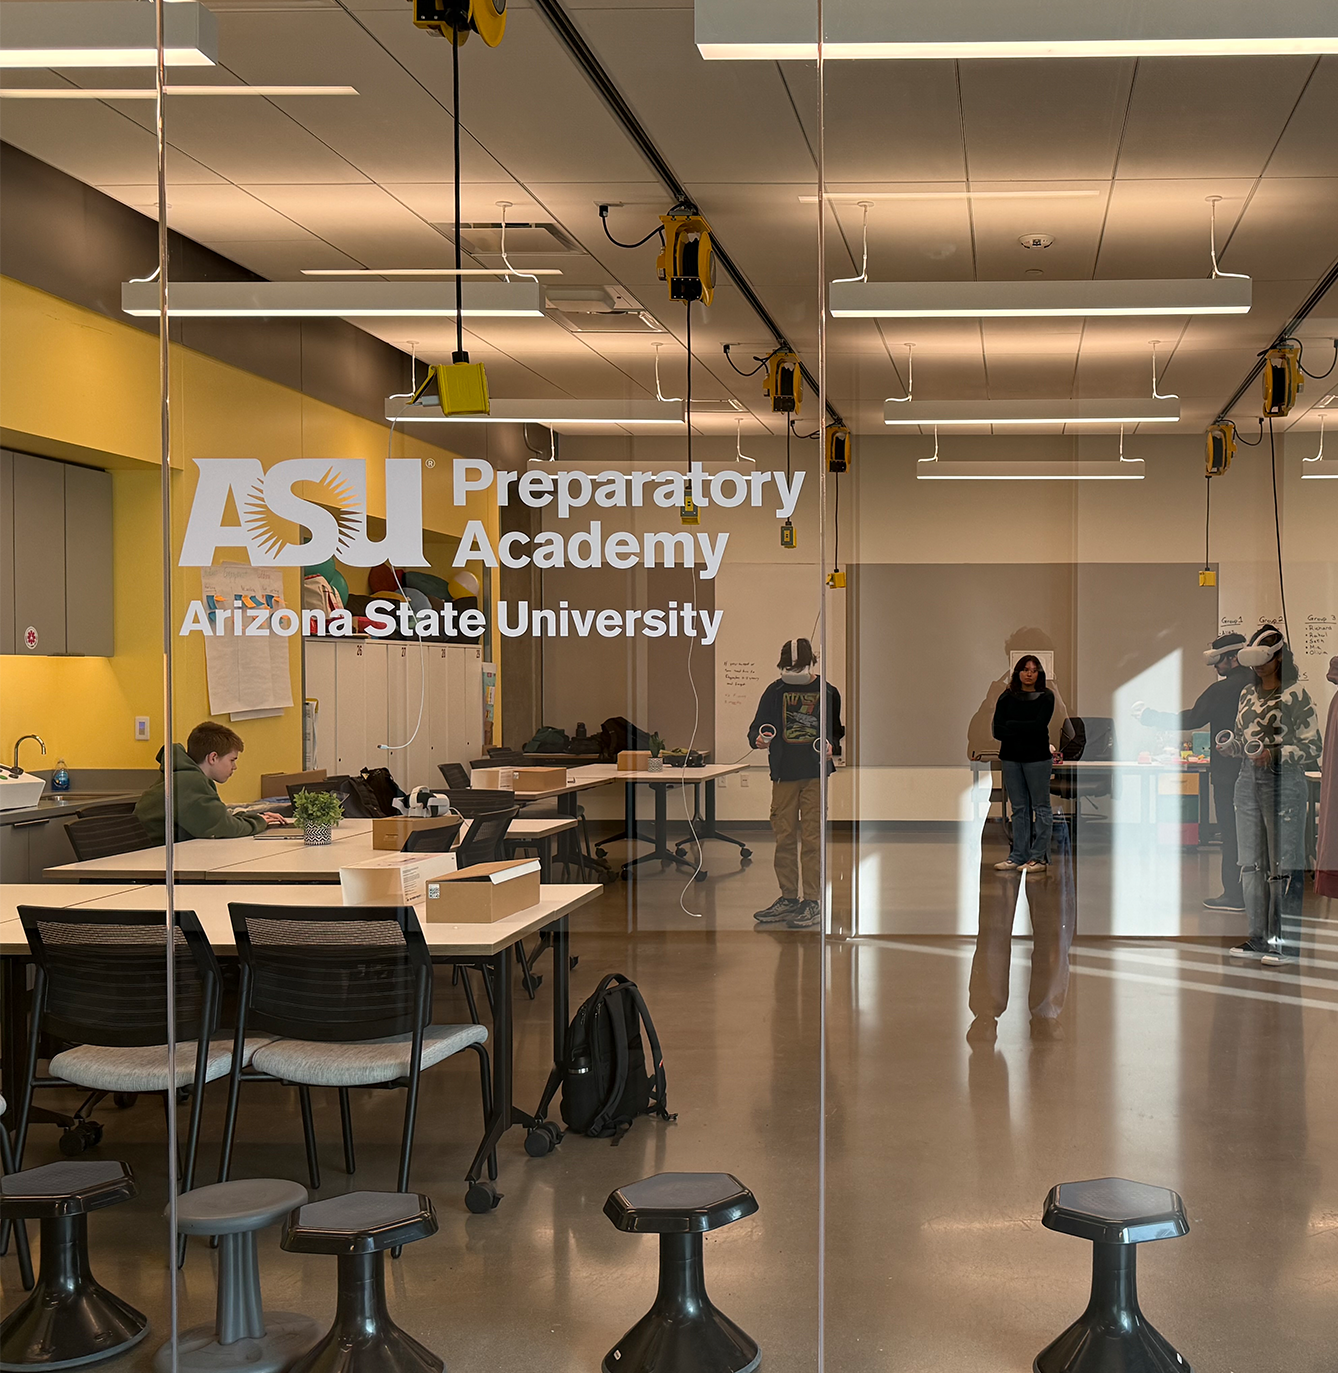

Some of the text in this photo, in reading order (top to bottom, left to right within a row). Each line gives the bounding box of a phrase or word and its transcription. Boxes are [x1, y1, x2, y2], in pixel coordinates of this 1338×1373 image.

[178, 458, 431, 567] ASU
[452, 458, 806, 518] Preparatory
[451, 520, 730, 579] Academy
[178, 600, 724, 646] Arizona State University
[1306, 614, 1327, 623] Group
